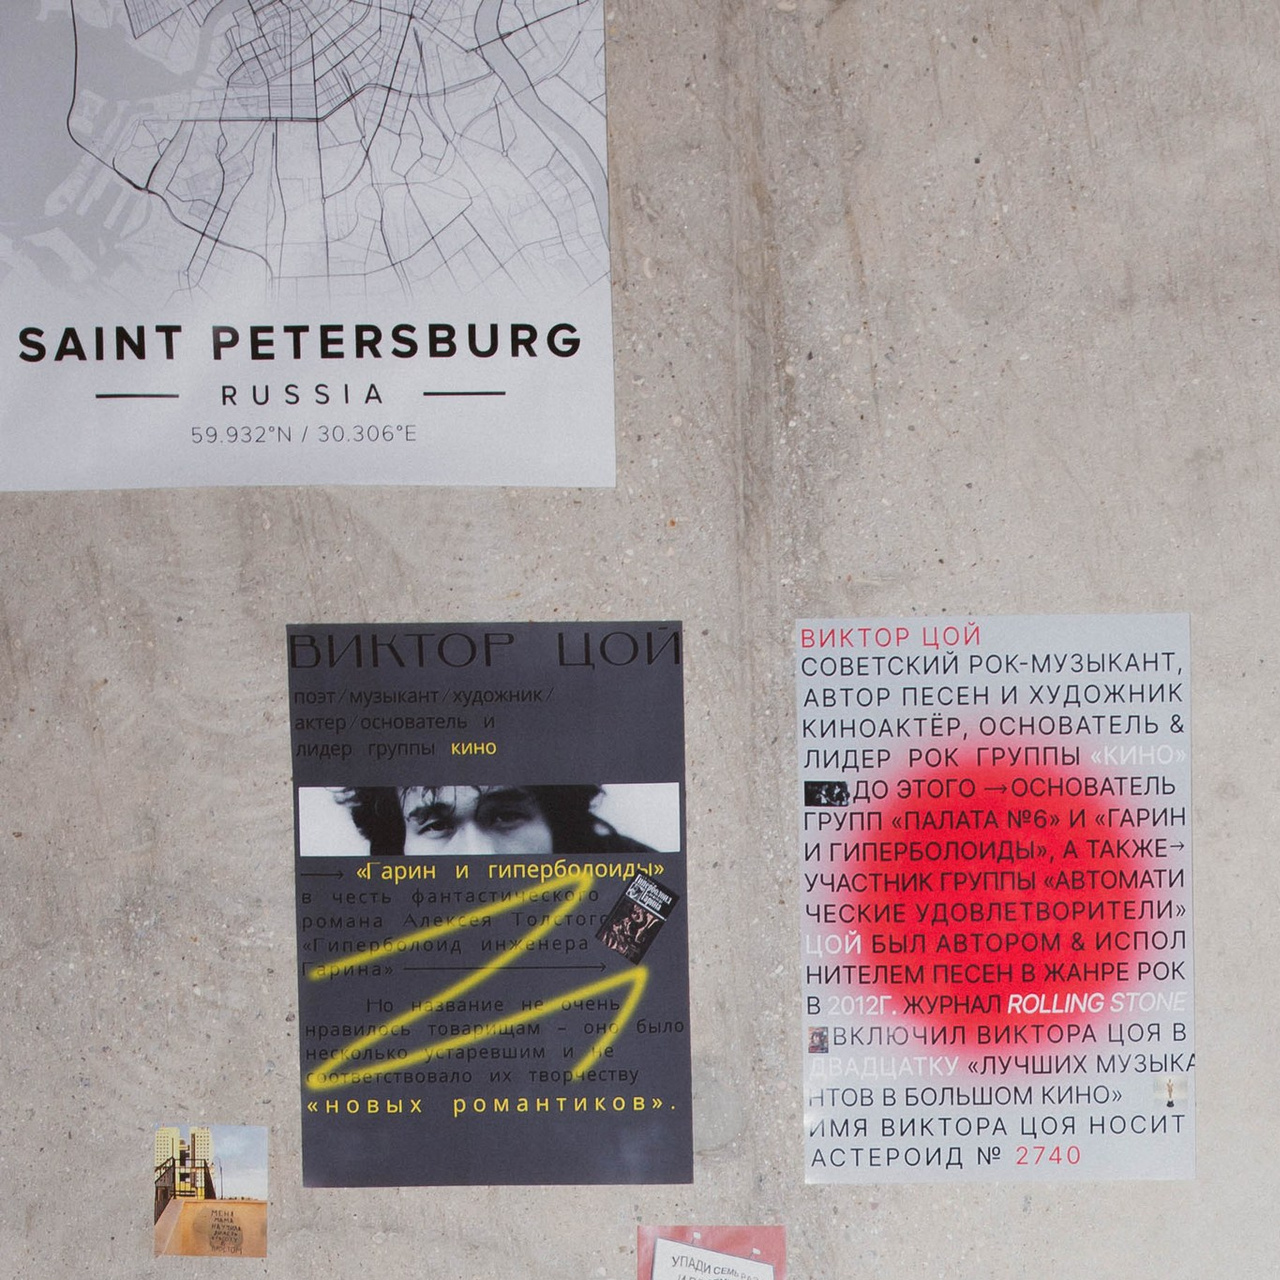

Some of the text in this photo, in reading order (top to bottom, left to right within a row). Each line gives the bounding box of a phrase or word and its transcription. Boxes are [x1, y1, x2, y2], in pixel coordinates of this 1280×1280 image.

[18, 324, 582, 362] SAINT PETERSBURG
[222, 384, 384, 406] RUSSIA
[192, 425, 292, 444] 59.932°N
[318, 424, 417, 443] 30.306°E
[290, 626, 681, 670] ВИКТОР ЦОЙ
[801, 622, 980, 650] ВИКТОР ЦОЙ
[801, 651, 1183, 676] СОВЕТСКИЙ РОК-МУЗЫКАНТ,
[804, 683, 1183, 707] АВТОР ПЕСЕН И ХУДОЖНИК
[803, 713, 1185, 740] КИНОАКТЁР, ОСНОВАТЕЛЬ &
[296, 740, 497, 760] лидер группы кино
[804, 744, 1186, 772] ЛИДЕР РОК ГРУППЫ «КИНО»
[853, 776, 1176, 801] ДО ЭТОГО ОСНОВАТЕЛЬ
[804, 812, 883, 831] ГРУПП
[891, 810, 999, 830] «ПАЛАТА
[1070, 809, 1085, 827] И
[1095, 807, 1186, 827] «ГАРИН
[805, 839, 1168, 864] И ГИПЕРБОЛОИДЫ», А ТАКЖЕ
[356, 860, 664, 885] «Гарин и гиперболоиды»
[805, 869, 1184, 892] УЧАСТНИК ГРУППЫ «АВТОМАТИ
[302, 887, 599, 908] в честь фантастического
[302, 915, 384, 931] романа
[403, 912, 492, 927] Алексея
[806, 900, 1186, 925] ЧЕСКИЕ УДОВЛЕТВОРИТЕЛИ»
[303, 936, 588, 955] «Гиперболоид инженера
[806, 930, 1186, 957] ЦОЙ БЫЛ АВТОРОМ & ИСПОЛ
[302, 961, 394, 979] Гарина»
[806, 960, 1186, 985] НИТЕЛЕМ ПЕСЕН В ЖАНРЕ РОК
[367, 996, 620, 1013] Но название не очень
[807, 991, 1187, 1016] В 2012Г. ЖУРНАЛ ROLLING STONE
[306, 1022, 411, 1038] нравилось
[429, 1020, 540, 1038] товарищам
[584, 1020, 619, 1034] оно
[637, 1017, 684, 1033] было
[833, 1022, 1186, 1046] ВКЛЮЧИЛ ВИКТОРА ЦОЯ В
[306, 1043, 614, 1062] несколько устаревшим и не
[306, 1067, 639, 1085] соответствовало их творчеству
[809, 1056, 959, 1079] ДВАДЦАТКУ
[967, 1055, 1087, 1076] «ЛУЧШИХ
[307, 1095, 676, 1118] «новых романтиков».
[809, 1084, 1122, 1107] НТОВ В БОЛЬШОМ КИНО»
[810, 1114, 1186, 1139] ИМЯ ВИКТОРА ЦОЯ НОСИТ
[811, 1147, 963, 1169] АСТЕРОИД
[1016, 1145, 1081, 1165] 2740
[672, 1255, 711, 1275] УПАДИ
[714, 1266, 740, 1279] СЕМЬ
